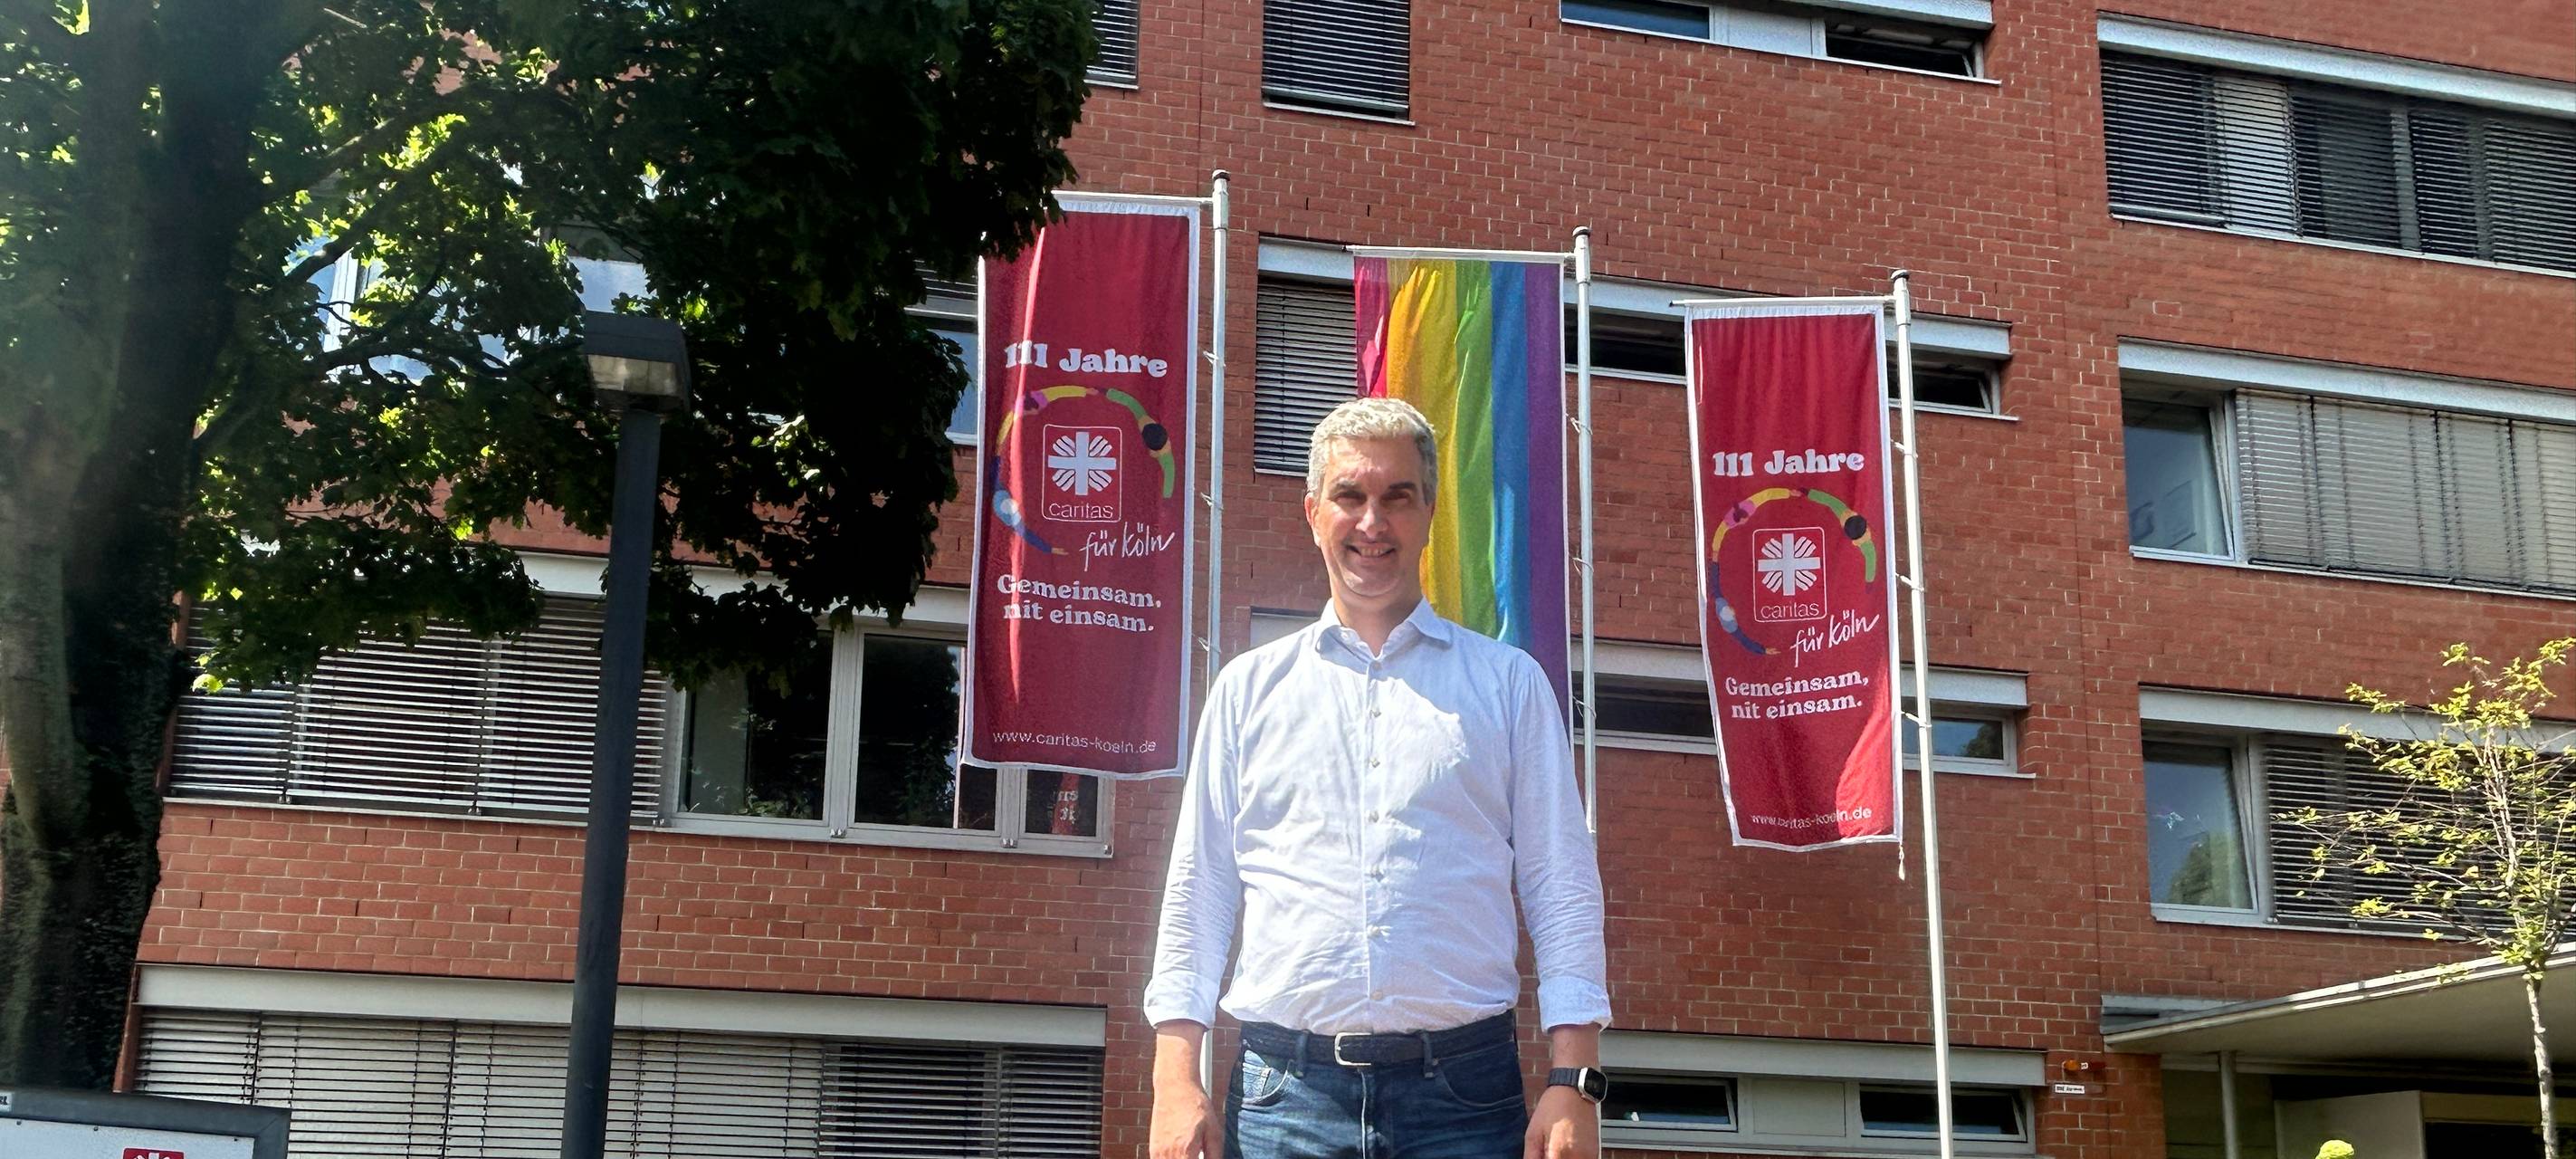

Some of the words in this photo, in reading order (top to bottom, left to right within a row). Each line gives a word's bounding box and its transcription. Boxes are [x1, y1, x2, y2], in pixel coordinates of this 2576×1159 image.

[1004, 340, 1048, 369] 111
[1058, 348, 1168, 378] Jahre
[1713, 451, 1755, 477] 111
[1764, 448, 1865, 474] Jahre
[1048, 503, 1114, 519] caritas
[1079, 530, 1117, 572] für
[997, 573, 1162, 608] Gemeinsam,
[1003, 599, 1044, 620] nit
[1049, 605, 1154, 632] einsam.
[1760, 600, 1820, 619] caritas
[1789, 627, 1825, 668] für
[1724, 670, 1869, 697] Gemeinsam,
[1731, 701, 1761, 719] nit
[1766, 694, 1863, 720] einsam.
[992, 732, 1157, 753] www.caritas-koeln.de
